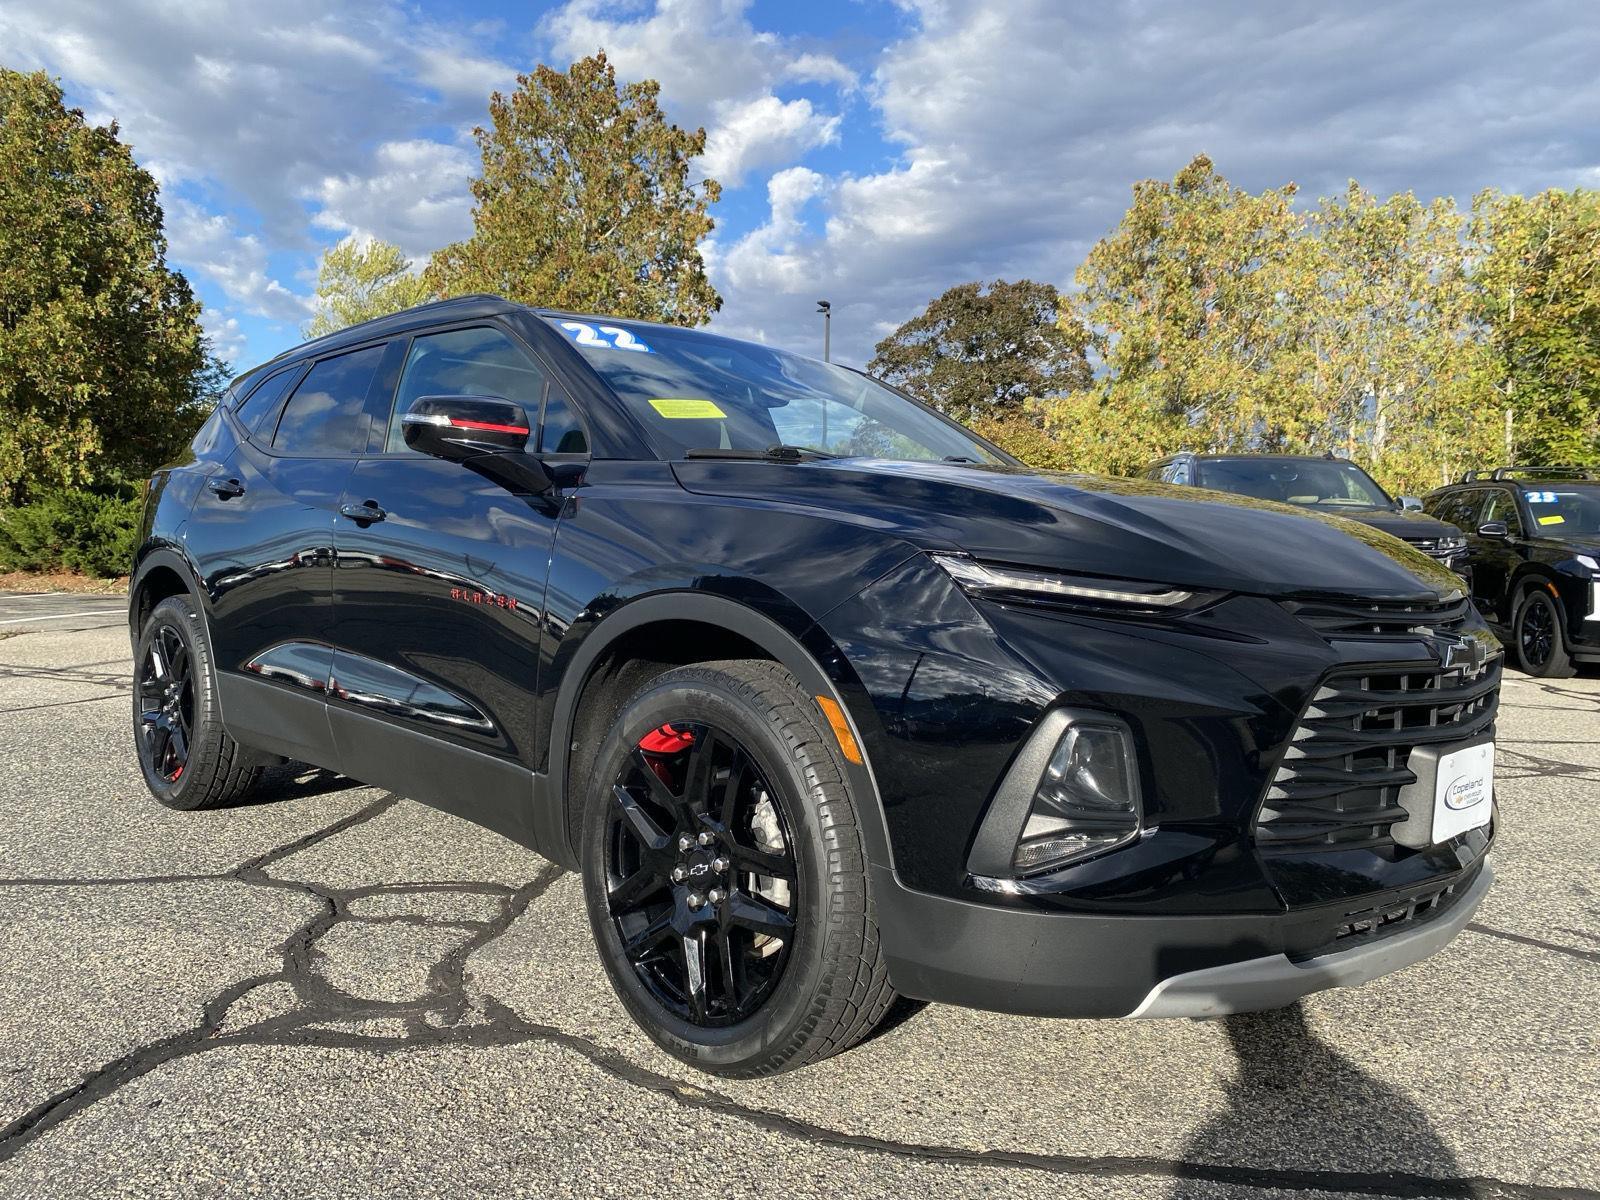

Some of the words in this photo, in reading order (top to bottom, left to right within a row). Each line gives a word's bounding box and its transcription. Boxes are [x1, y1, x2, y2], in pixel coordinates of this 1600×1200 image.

[561, 322, 649, 352] 22
[1527, 491, 1556, 503] 23
[450, 588, 517, 609] BLAZER
[1453, 778, 1483, 795] Copeland
